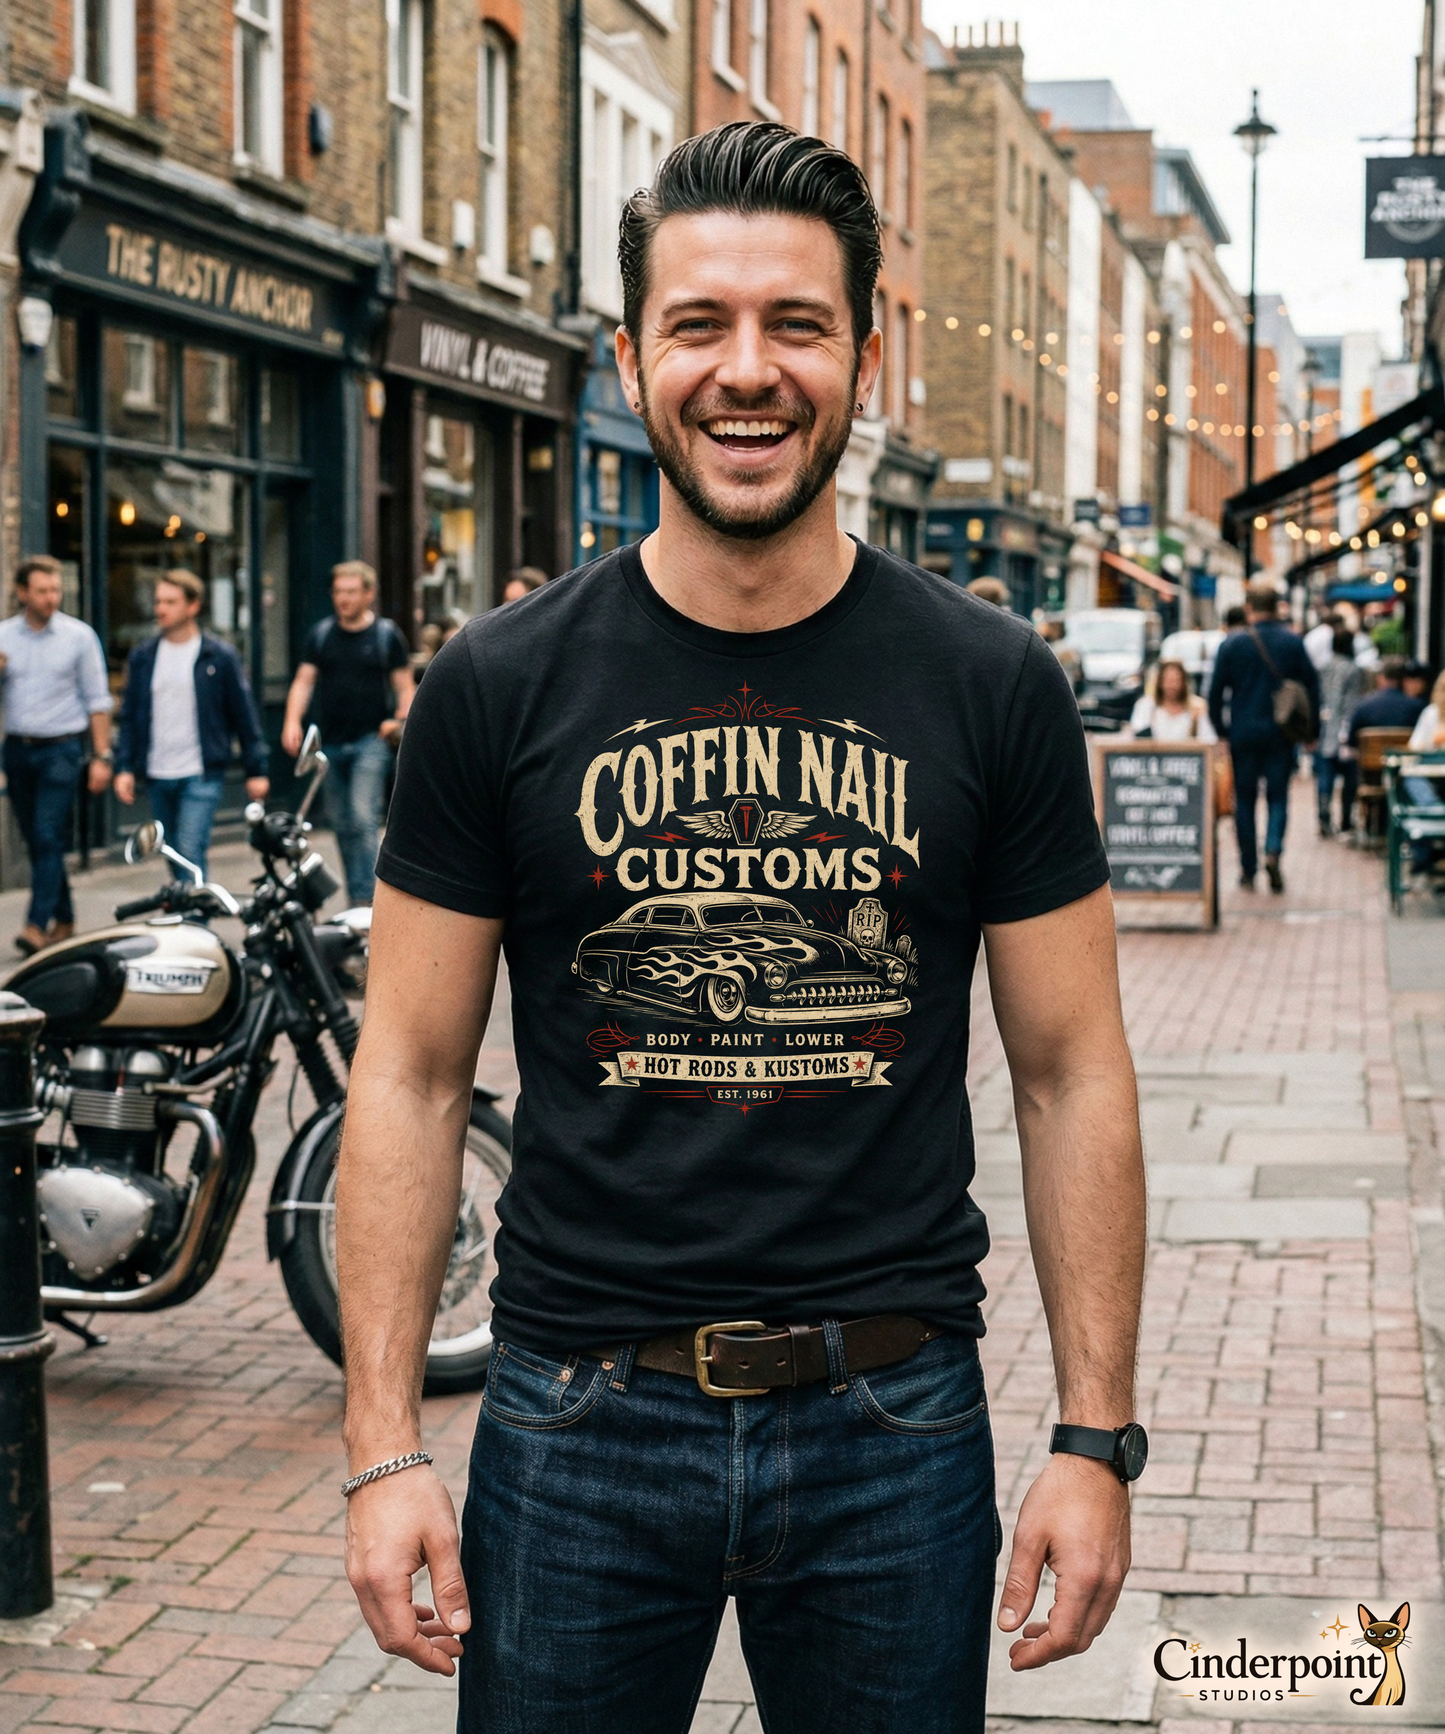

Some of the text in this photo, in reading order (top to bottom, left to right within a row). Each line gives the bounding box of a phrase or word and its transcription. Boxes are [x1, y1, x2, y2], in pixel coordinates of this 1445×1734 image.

[106, 224, 313, 332] THE RUSTY ANCHOR
[574, 725, 920, 869] COFFIN NAIL
[615, 847, 882, 891] CUSTOMS
[856, 913, 882, 927] RIP
[646, 1033, 844, 1046] BODY PAINT LOWER
[644, 1056, 849, 1078] HOT RODS & KUSTOMS
[717, 1090, 773, 1099] EST. 1961
